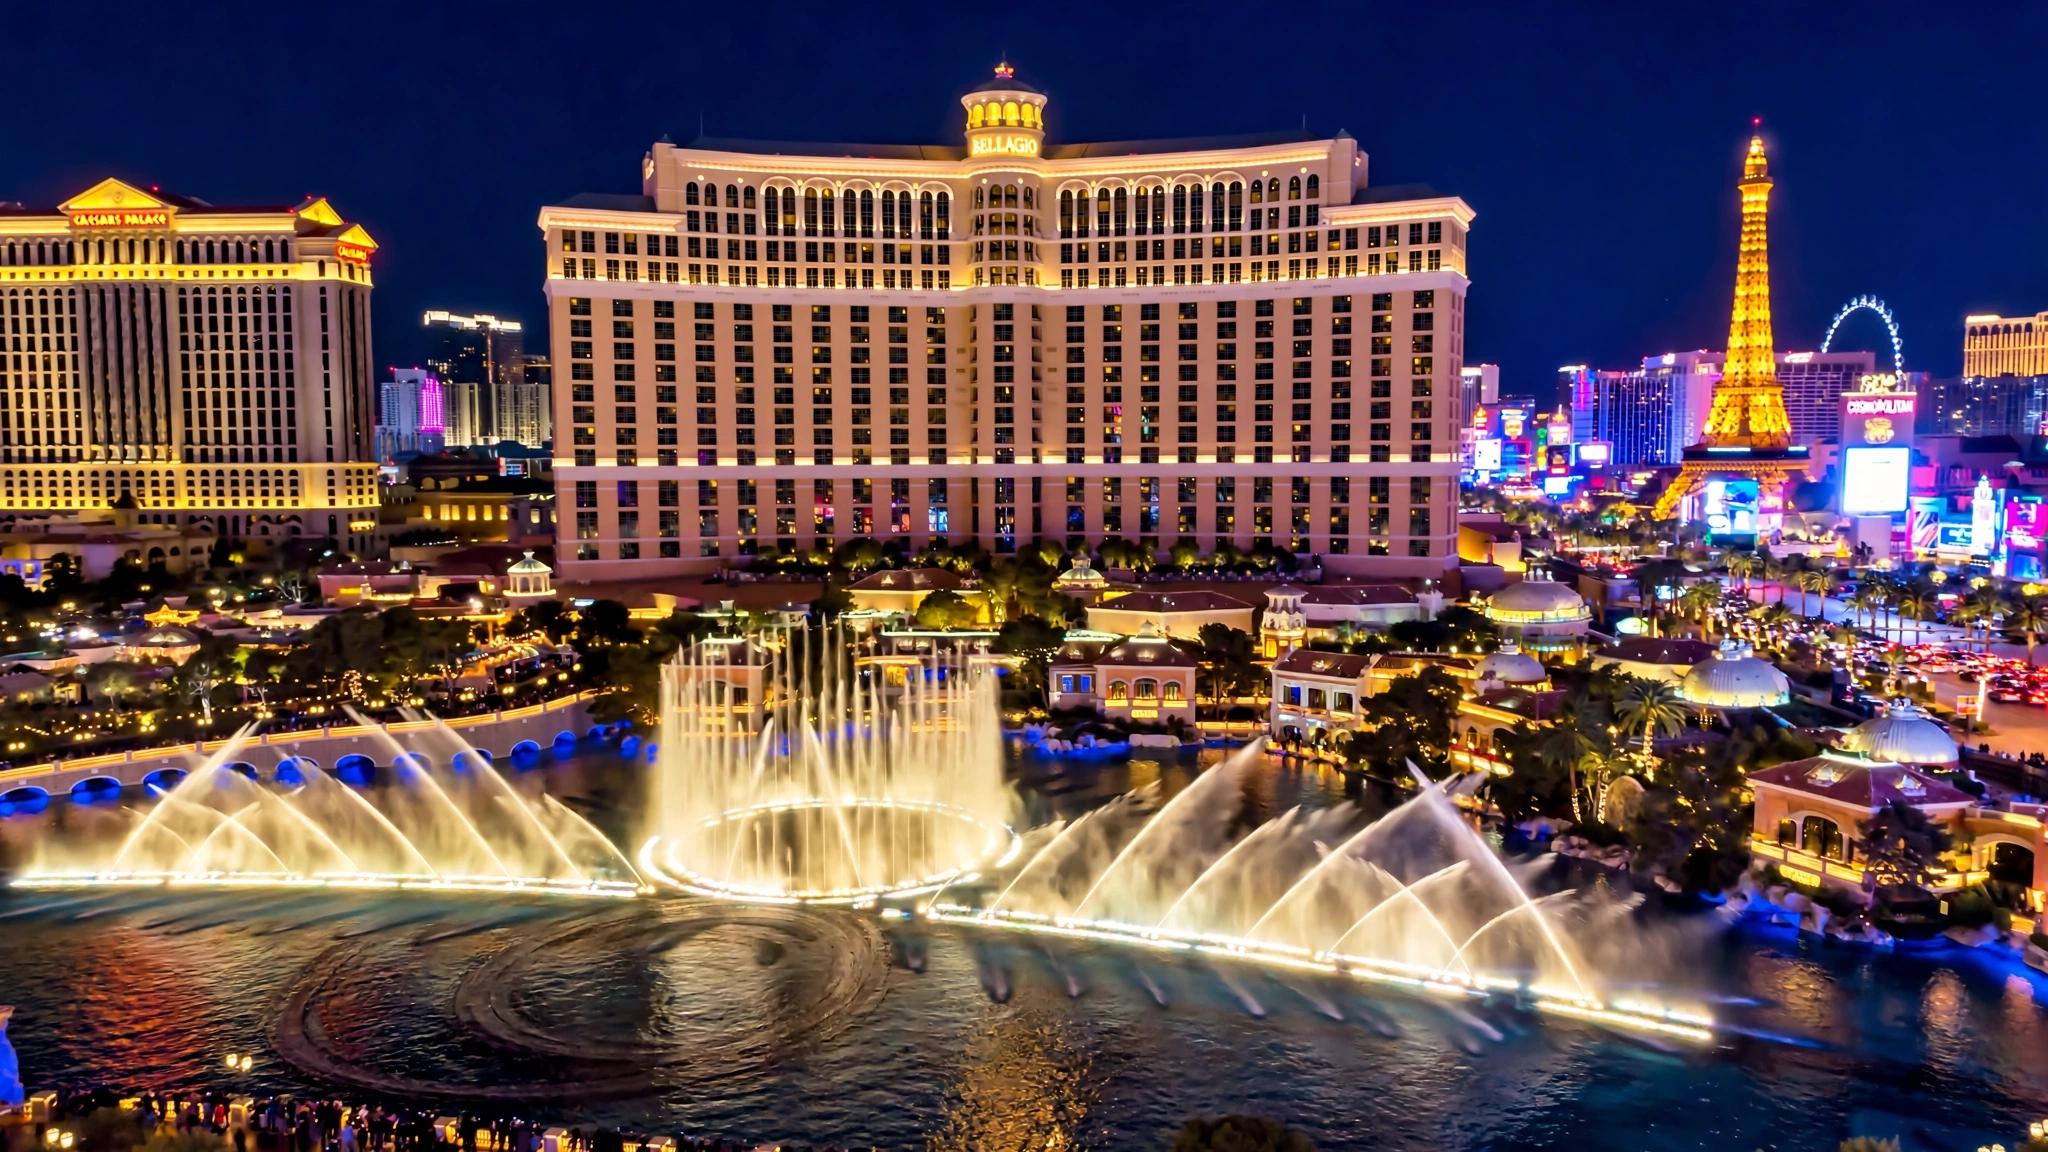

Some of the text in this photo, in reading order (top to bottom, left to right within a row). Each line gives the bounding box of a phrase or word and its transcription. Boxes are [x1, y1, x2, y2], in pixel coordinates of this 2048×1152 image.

[972, 136, 1037, 155] BELLAGIO
[73, 213, 167, 226] CAESARS PALACE
[1847, 399, 1914, 415] COSMOPOLITAN
